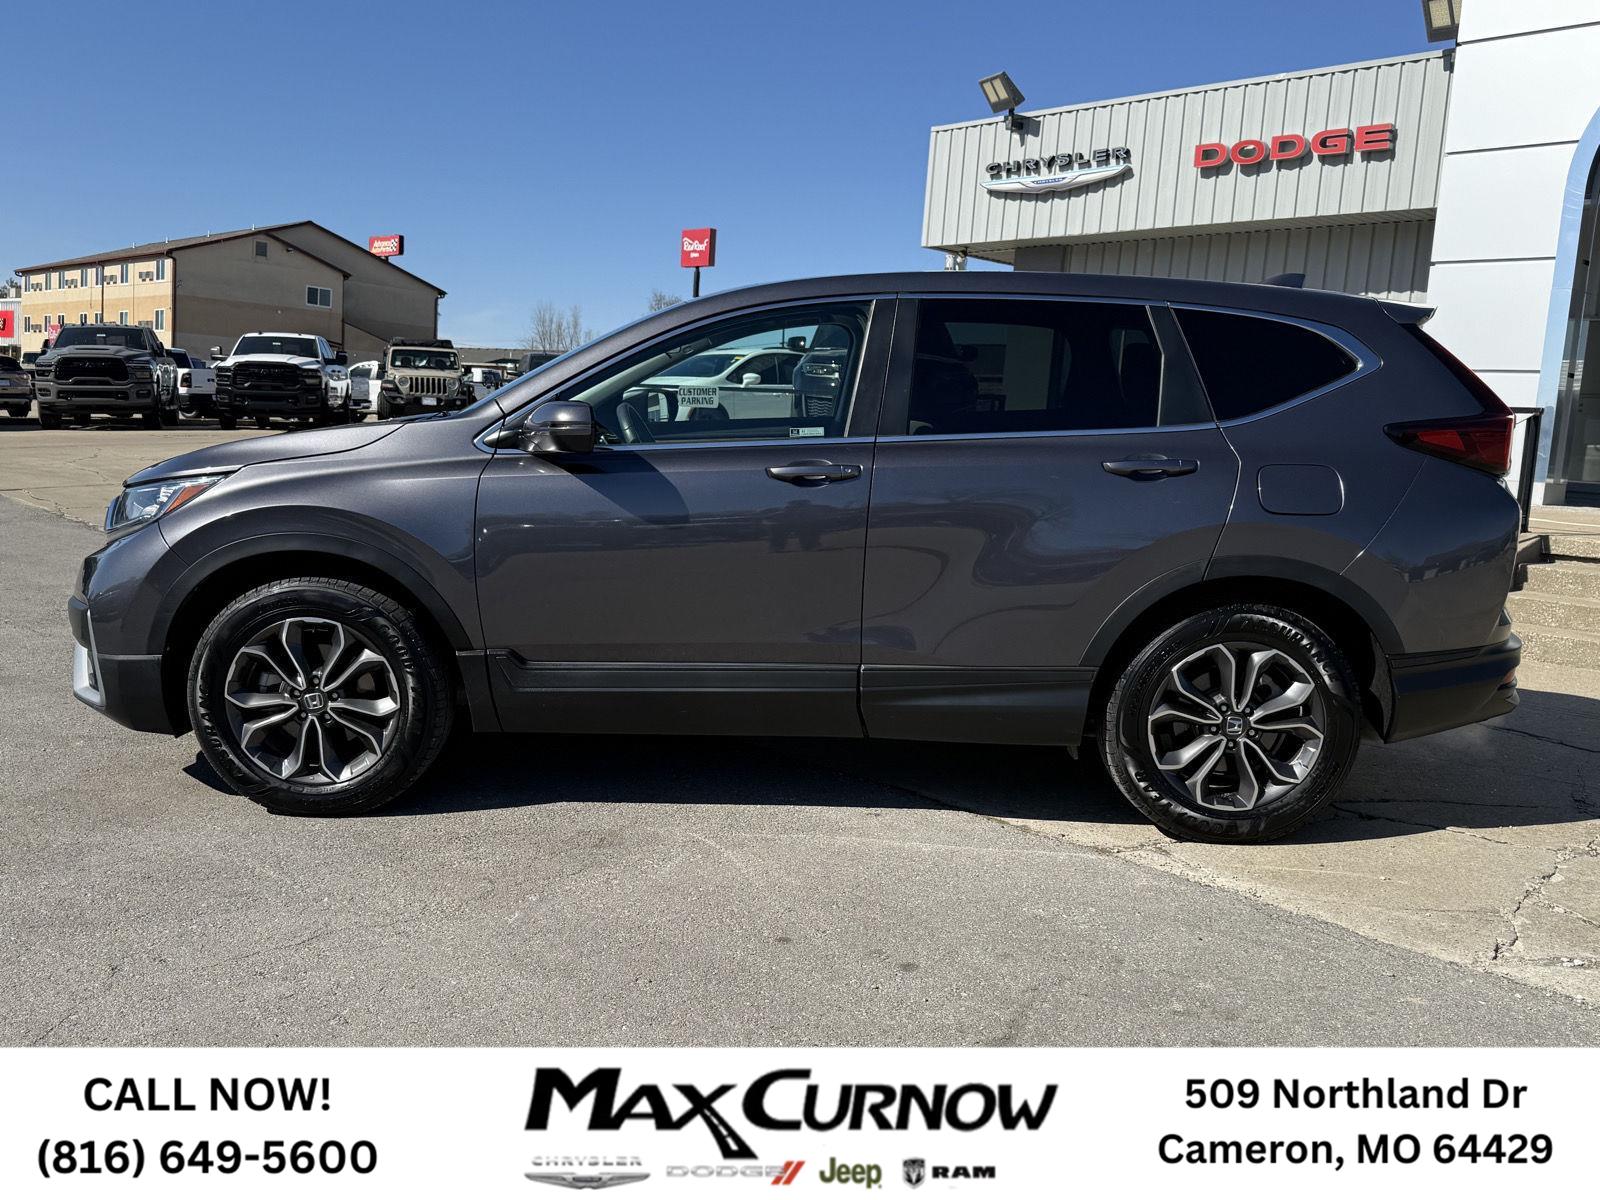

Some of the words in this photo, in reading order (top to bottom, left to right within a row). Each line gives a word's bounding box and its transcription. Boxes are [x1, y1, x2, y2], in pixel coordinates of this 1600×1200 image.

[1194, 124, 1393, 169] DODGE
[986, 146, 1129, 175] CHRYSLER
[678, 387, 717, 396] CUSTOMER
[681, 396, 714, 405] PARKING
